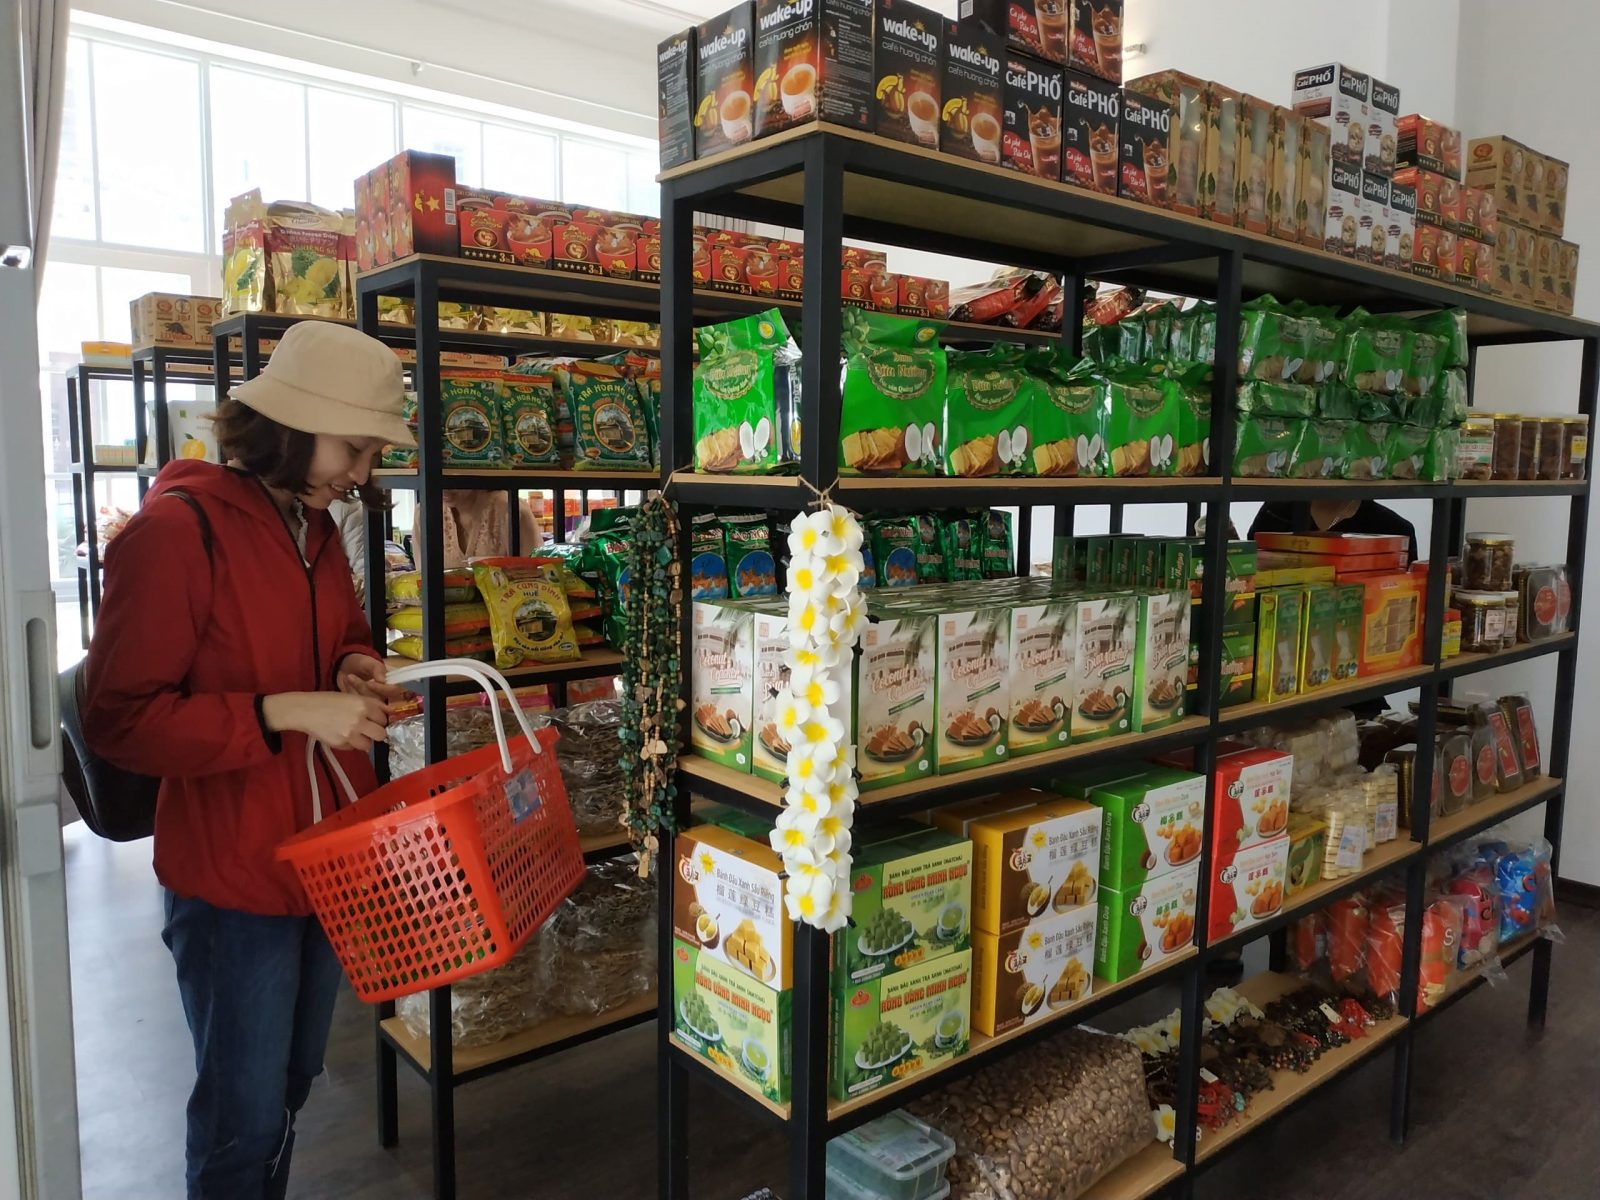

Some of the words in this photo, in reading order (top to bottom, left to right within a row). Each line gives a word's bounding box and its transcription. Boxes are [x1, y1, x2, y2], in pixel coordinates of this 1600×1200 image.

[1027, 71, 1061, 100] PHỐ
[1088, 90, 1119, 117] PHỐ
[1142, 107, 1170, 133] PHỐ
